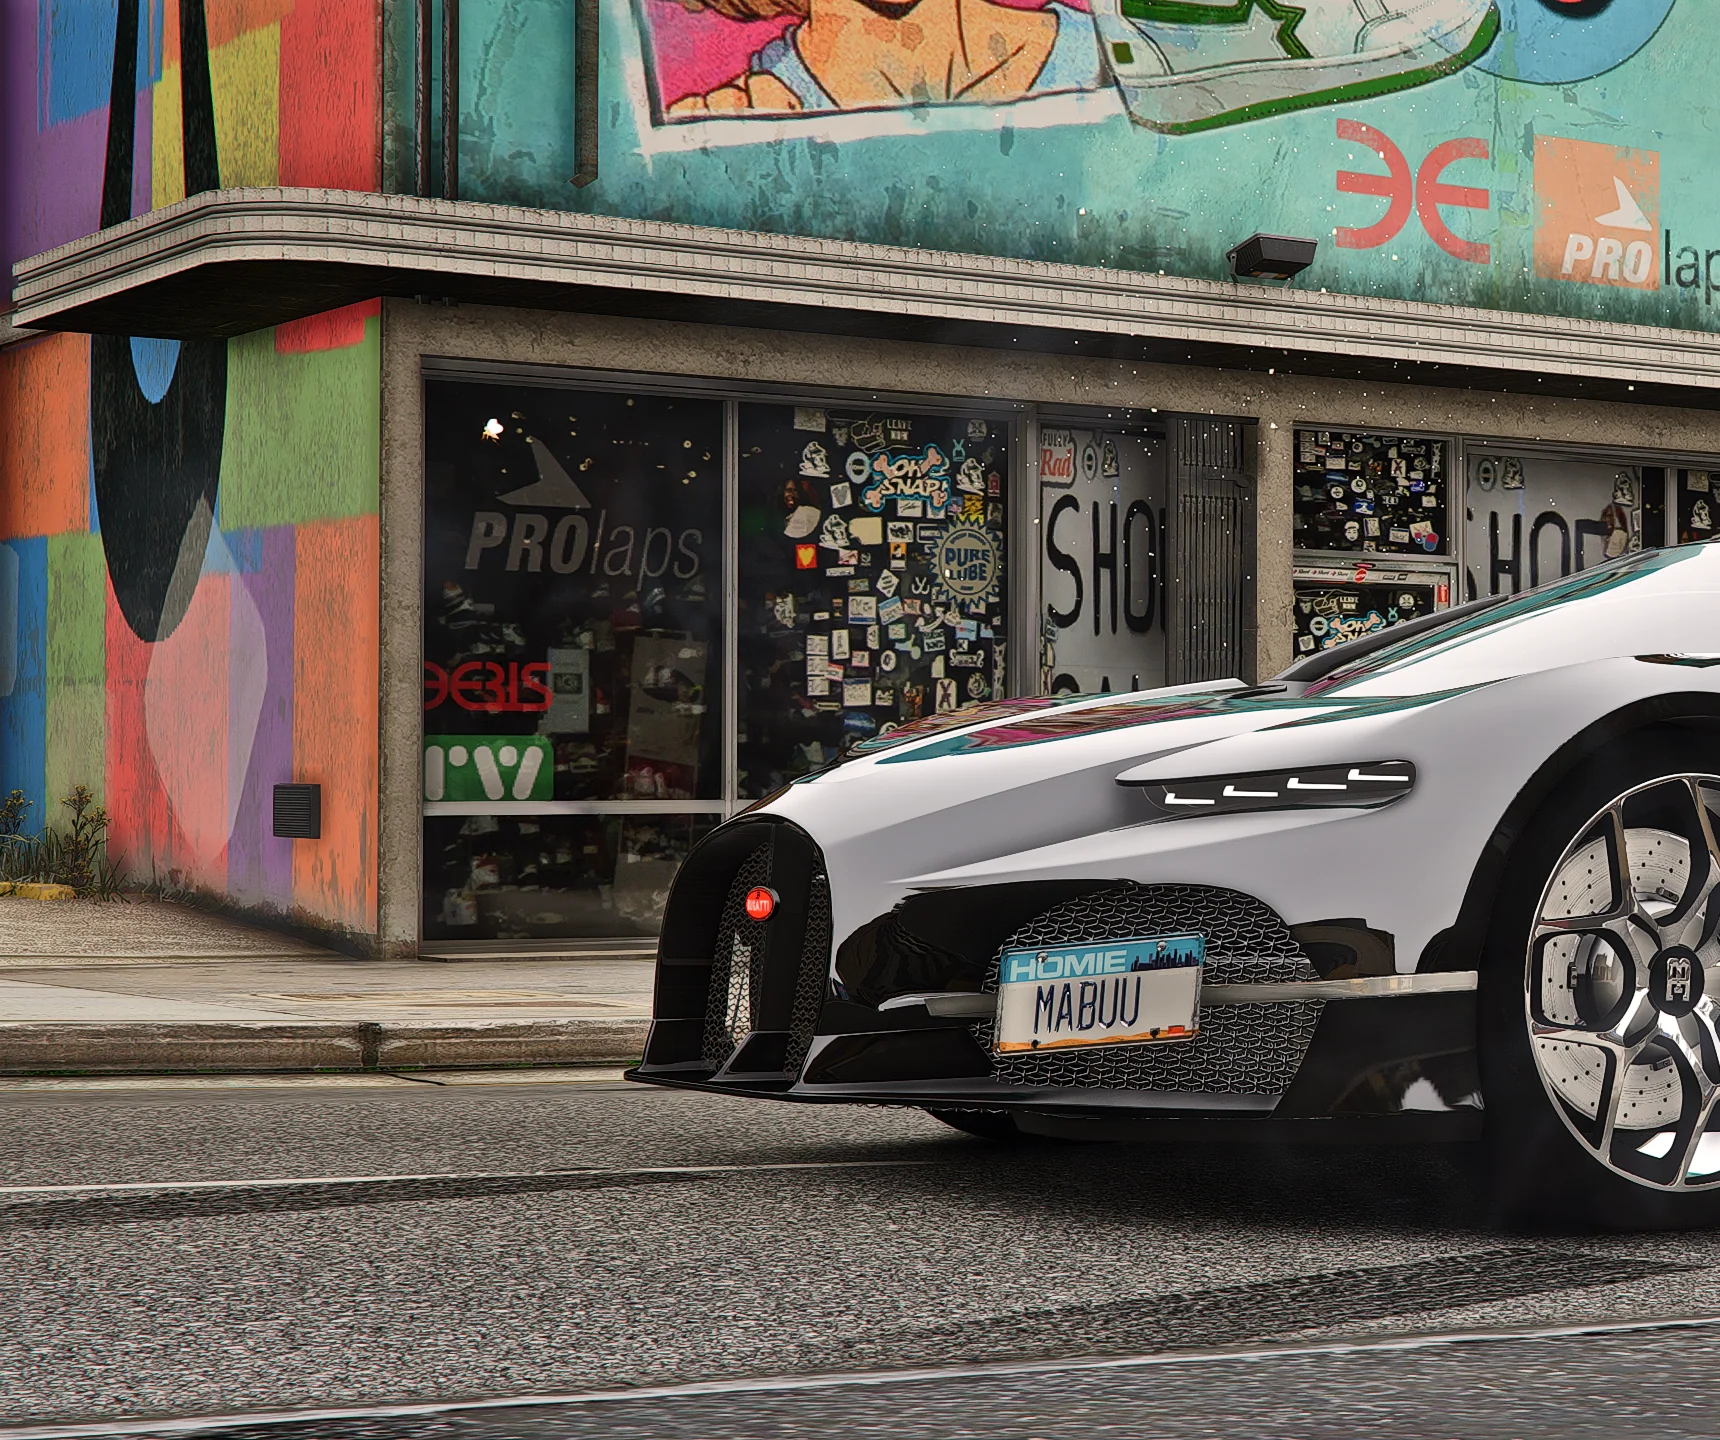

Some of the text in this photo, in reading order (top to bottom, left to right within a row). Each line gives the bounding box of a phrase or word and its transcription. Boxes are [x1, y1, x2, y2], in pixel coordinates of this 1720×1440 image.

[1040, 448, 1072, 477] Rad
[945, 547, 991, 567] PURE
[946, 563, 987, 580] LUBE
[1046, 494, 1165, 636] SHO
[1010, 950, 1127, 982] HOMIE
[1033, 975, 1142, 1034] MABUU
